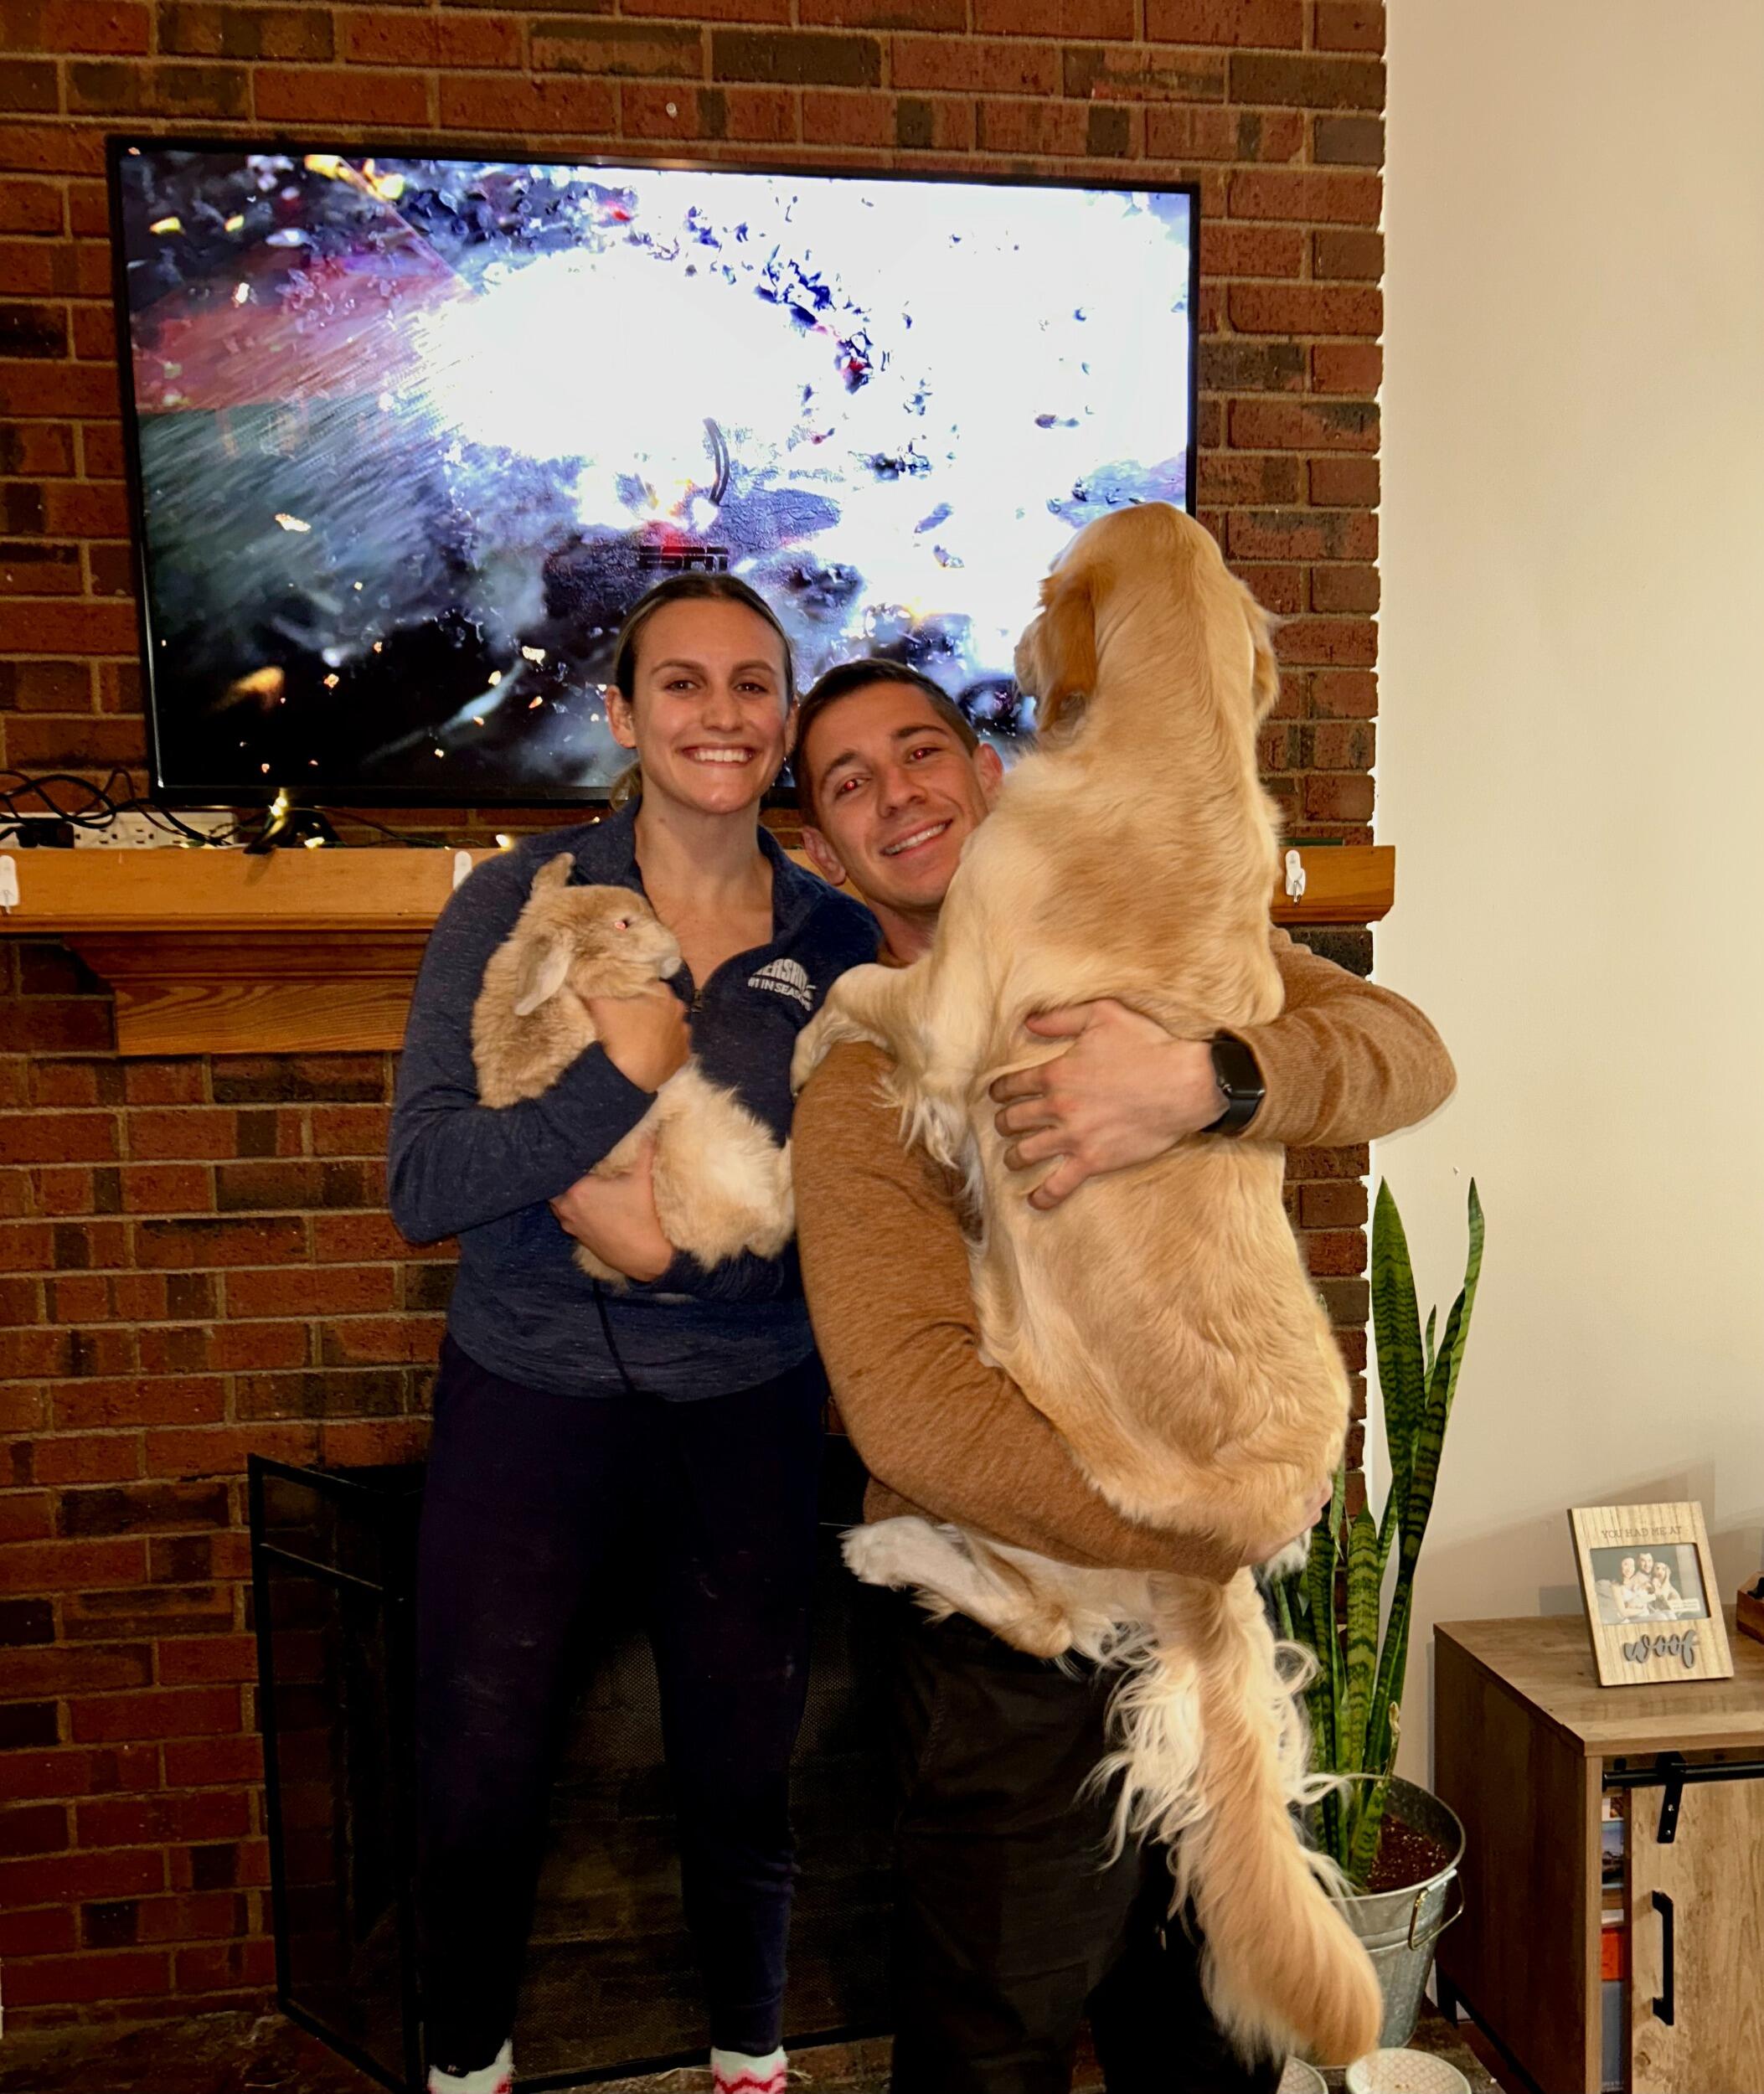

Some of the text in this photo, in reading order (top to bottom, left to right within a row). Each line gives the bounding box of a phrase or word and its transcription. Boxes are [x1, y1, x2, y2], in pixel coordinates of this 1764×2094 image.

[639, 545, 729, 571] ESPN
[761, 979, 775, 991] IN
[1602, 1525, 1682, 1539] YOU HAD ME AT
[1623, 1629, 1700, 1669] woof
